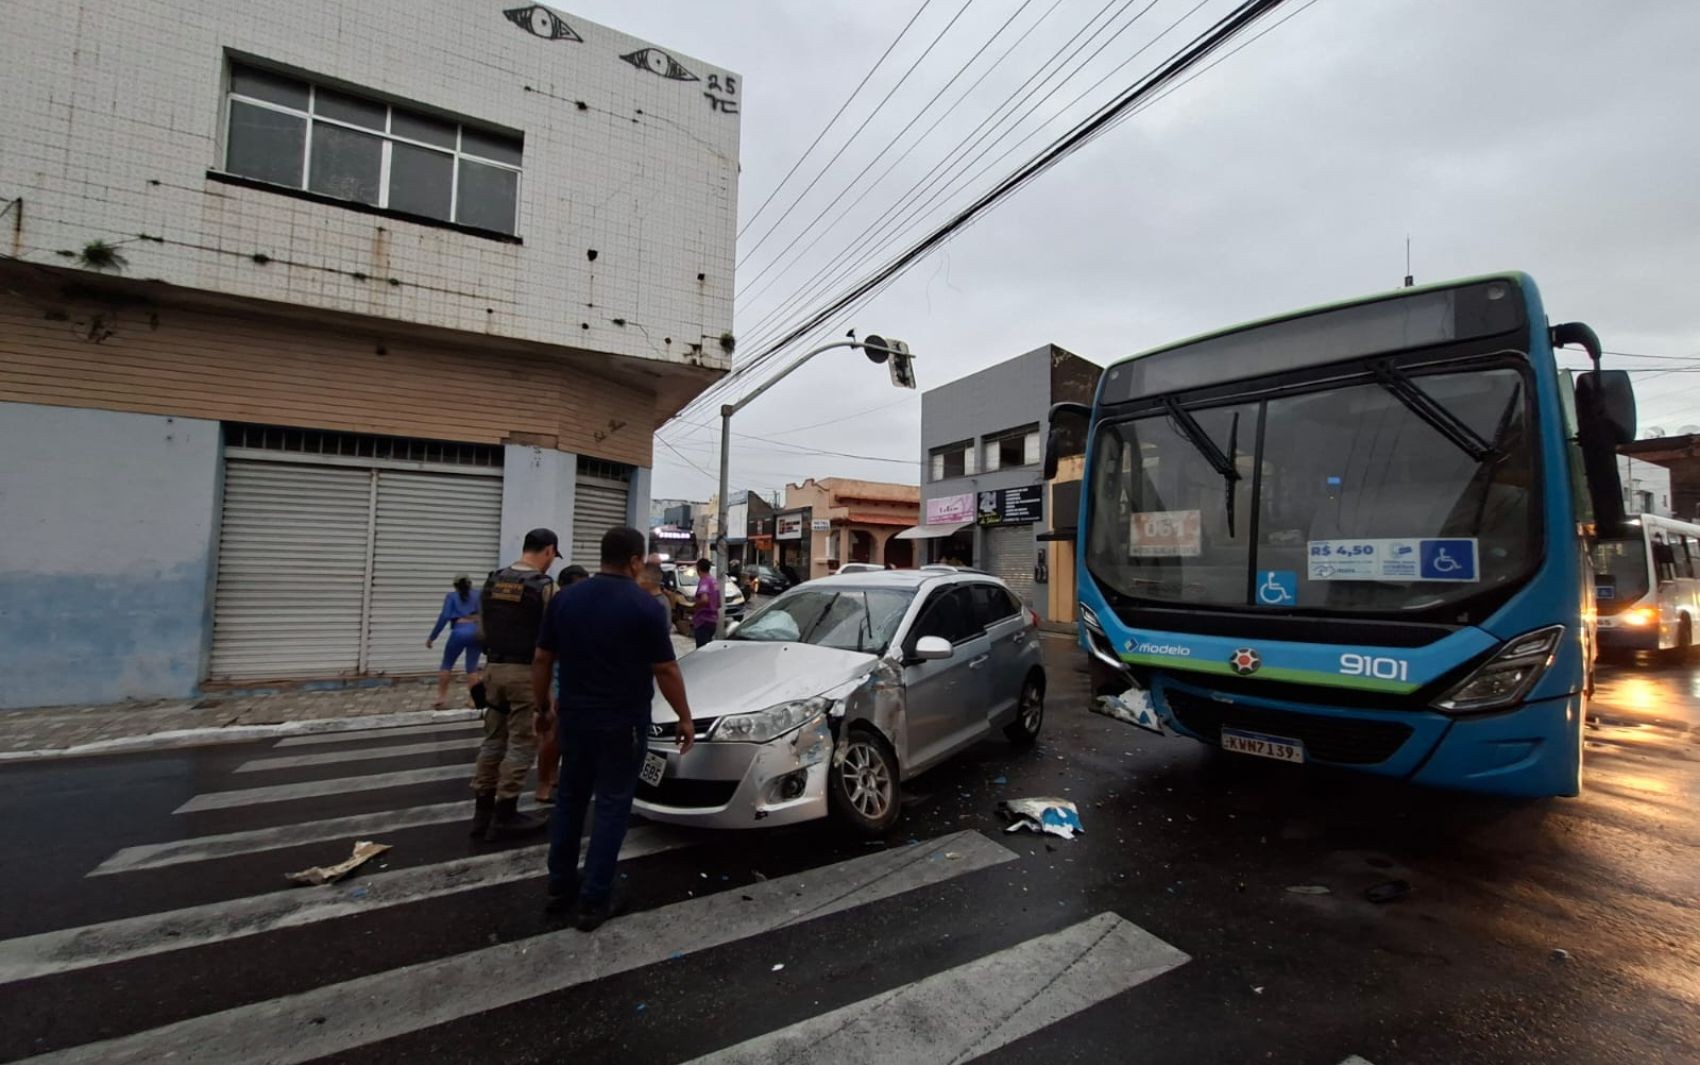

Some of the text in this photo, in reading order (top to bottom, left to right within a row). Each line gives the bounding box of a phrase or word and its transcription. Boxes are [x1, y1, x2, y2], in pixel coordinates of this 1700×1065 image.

[708, 74, 736, 95] 25
[1311, 545, 1374, 557] R$ 4,50
[1339, 653, 1408, 681] 9101
